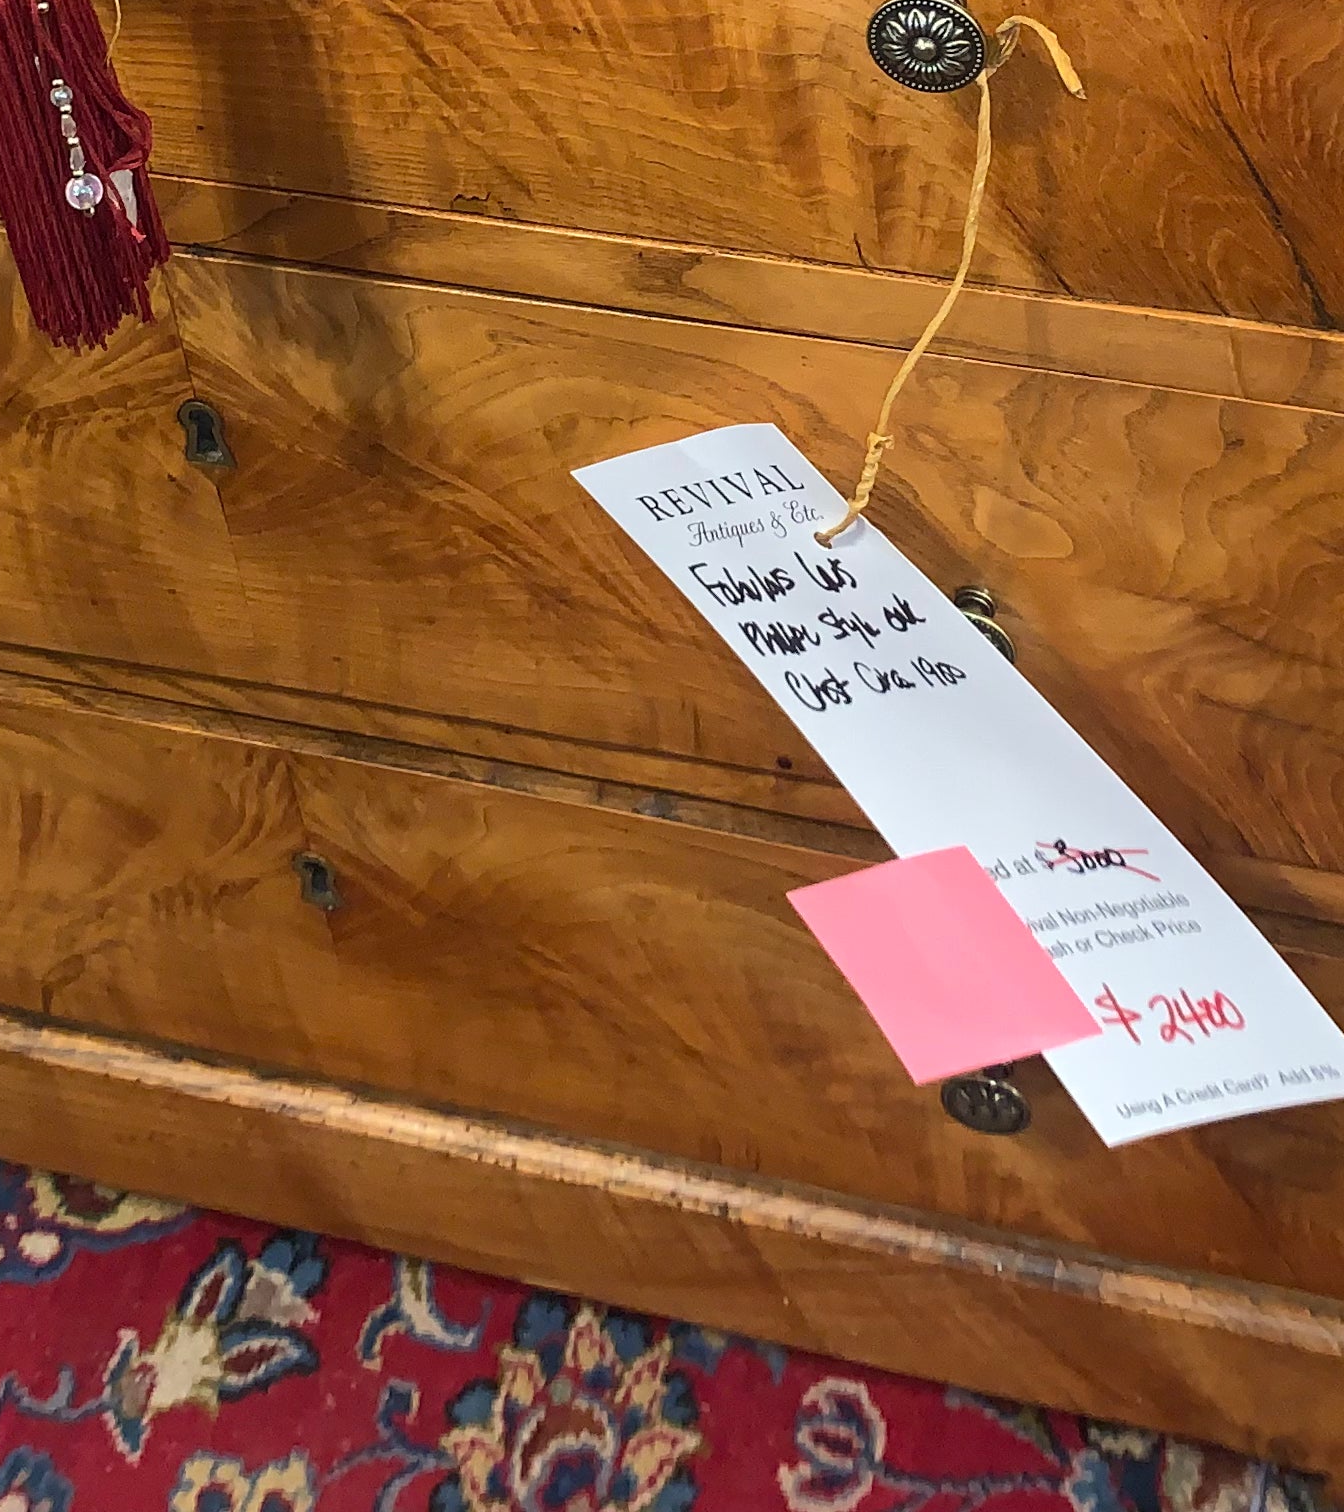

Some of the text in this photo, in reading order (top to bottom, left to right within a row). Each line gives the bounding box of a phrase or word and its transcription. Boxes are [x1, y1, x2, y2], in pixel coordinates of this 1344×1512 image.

[635, 465, 805, 521] REVIVAL
[687, 500, 824, 548] Antiques & Etc.
[1013, 855, 1038, 876] at
[1058, 890, 1191, 927] Non-Negotiable
[1075, 938, 1094, 954] or
[1094, 923, 1156, 949] Check
[1151, 918, 1203, 938] Price
[1116, 1098, 1163, 1120] Using
[1161, 1092, 1177, 1109] A
[1176, 1083, 1225, 1105] Credit
